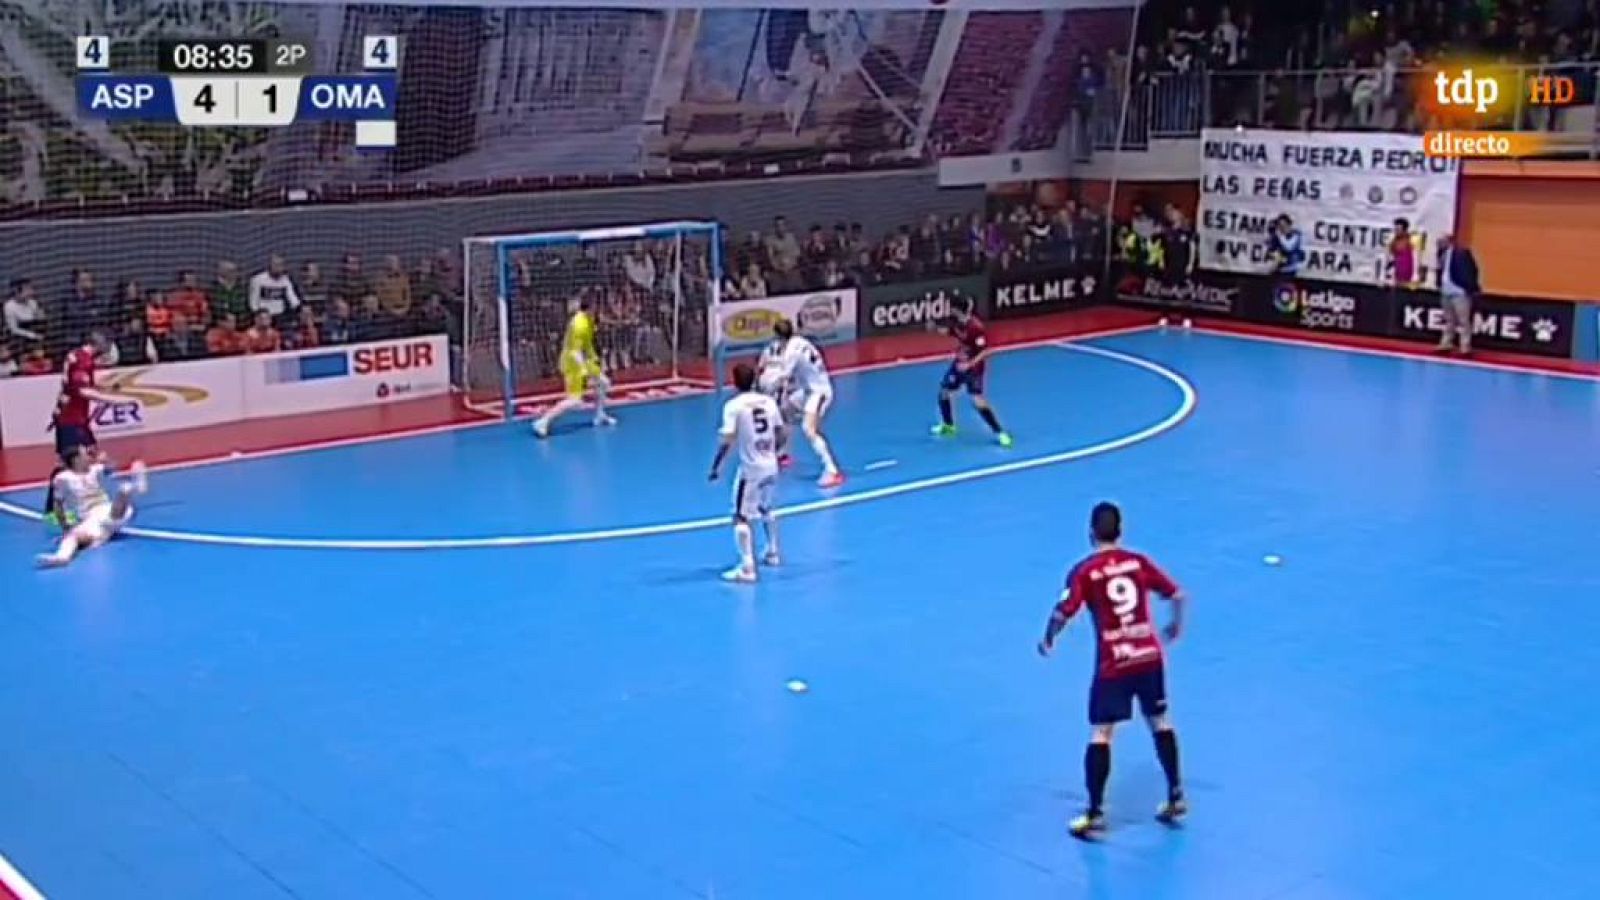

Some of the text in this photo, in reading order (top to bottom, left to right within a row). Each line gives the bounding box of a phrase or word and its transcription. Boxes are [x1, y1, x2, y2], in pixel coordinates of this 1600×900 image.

[1204, 141, 1268, 163] MUCHA
[1283, 145, 1363, 168] FUERZA
[1203, 174, 1240, 194] LAS
[996, 279, 1076, 308] KELME
[1404, 305, 1522, 339] KEME
[354, 343, 432, 374] SEUR
[752, 408, 768, 434] 5
[1106, 577, 1137, 615] 9
